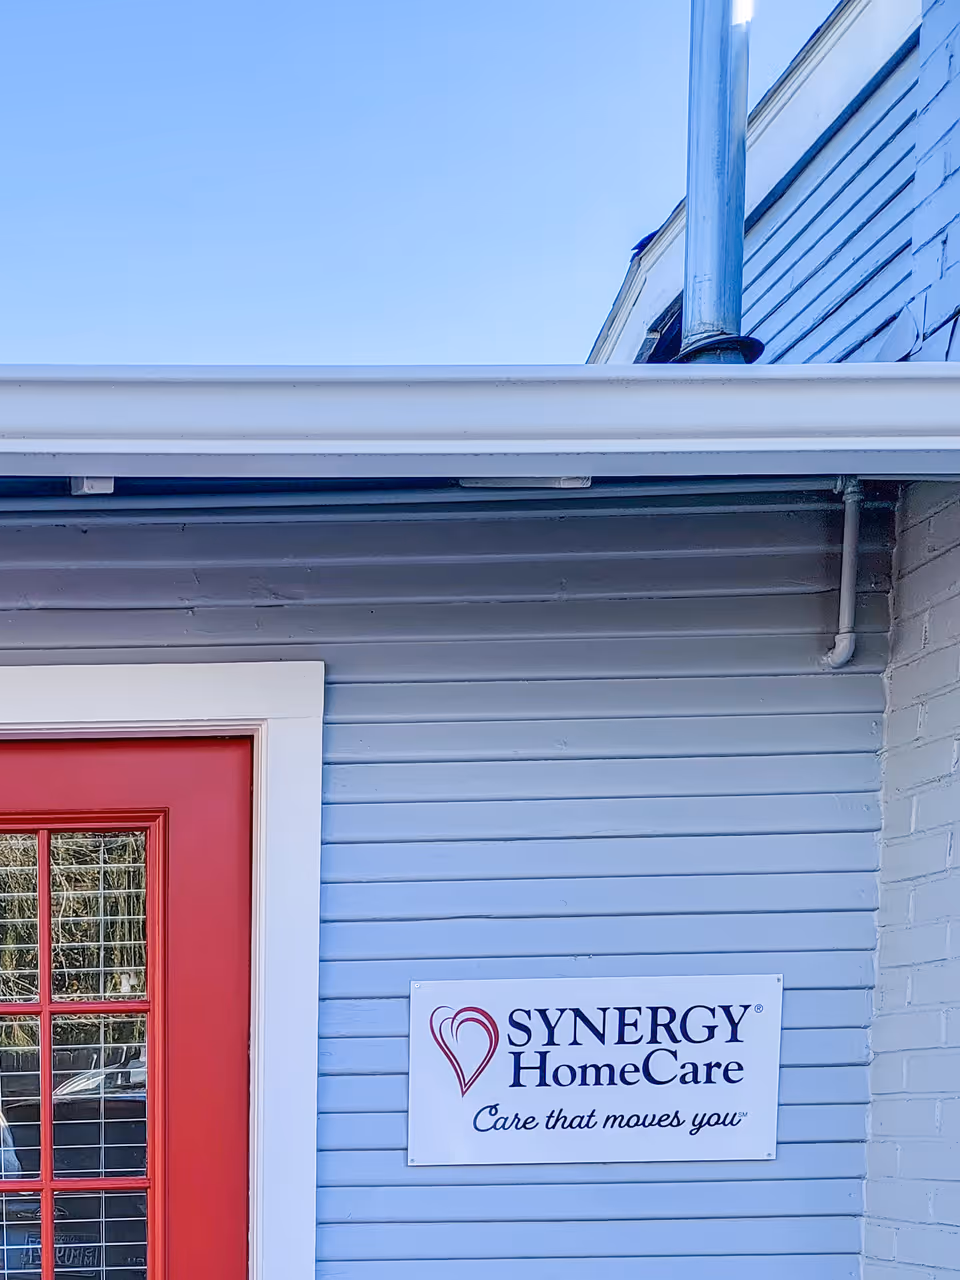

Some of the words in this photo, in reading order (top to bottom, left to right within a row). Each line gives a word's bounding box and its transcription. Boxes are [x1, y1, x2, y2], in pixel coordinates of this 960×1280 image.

[508, 1048, 745, 1088] HomeCare
[472, 1103, 539, 1133] Care
[545, 1108, 598, 1130] that
[602, 1110, 686, 1129] moves
